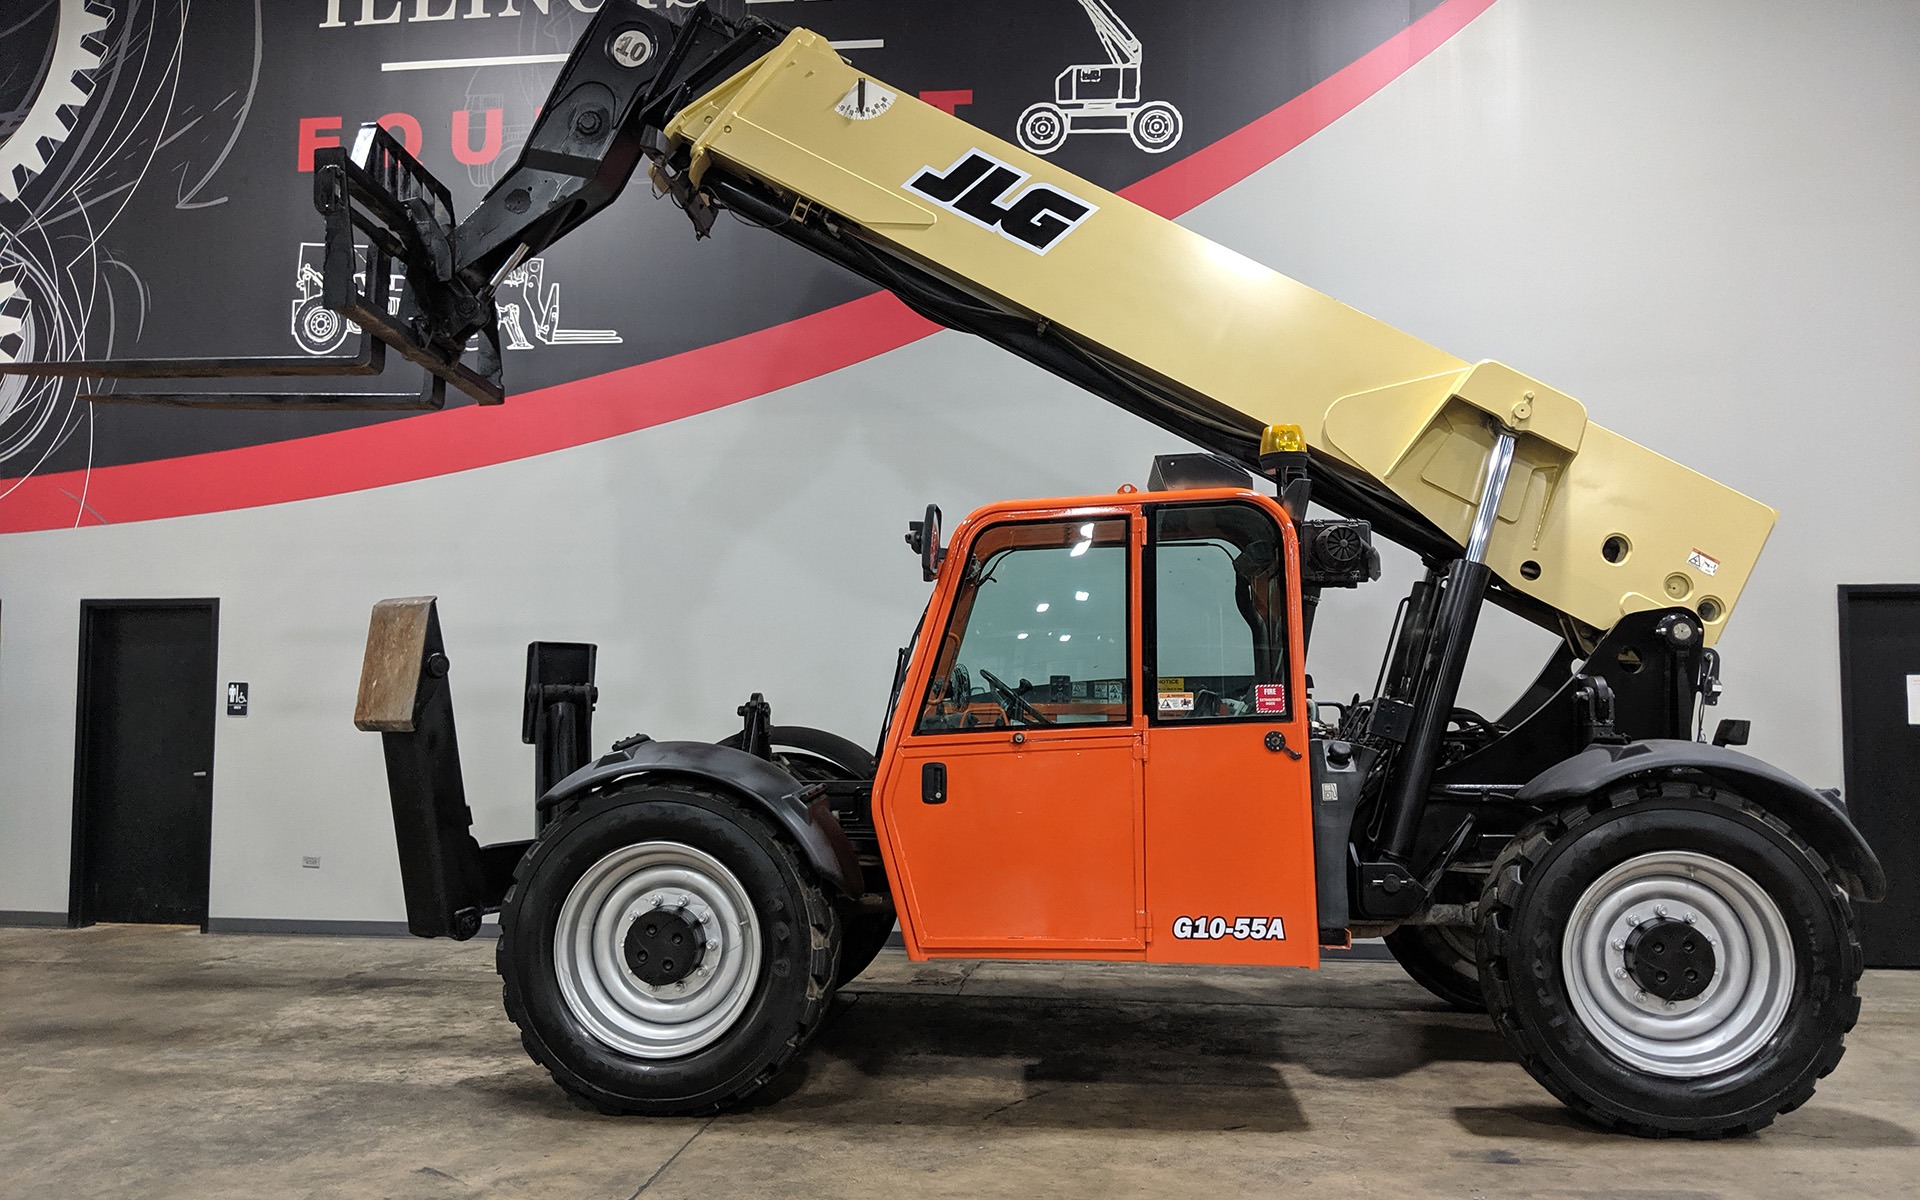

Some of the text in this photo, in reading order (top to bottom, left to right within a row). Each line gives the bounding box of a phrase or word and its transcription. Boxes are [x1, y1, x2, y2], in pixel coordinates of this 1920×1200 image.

[616, 36, 646, 61] 10
[905, 150, 1096, 253] JLG
[1172, 916, 1286, 940] G10-55A
